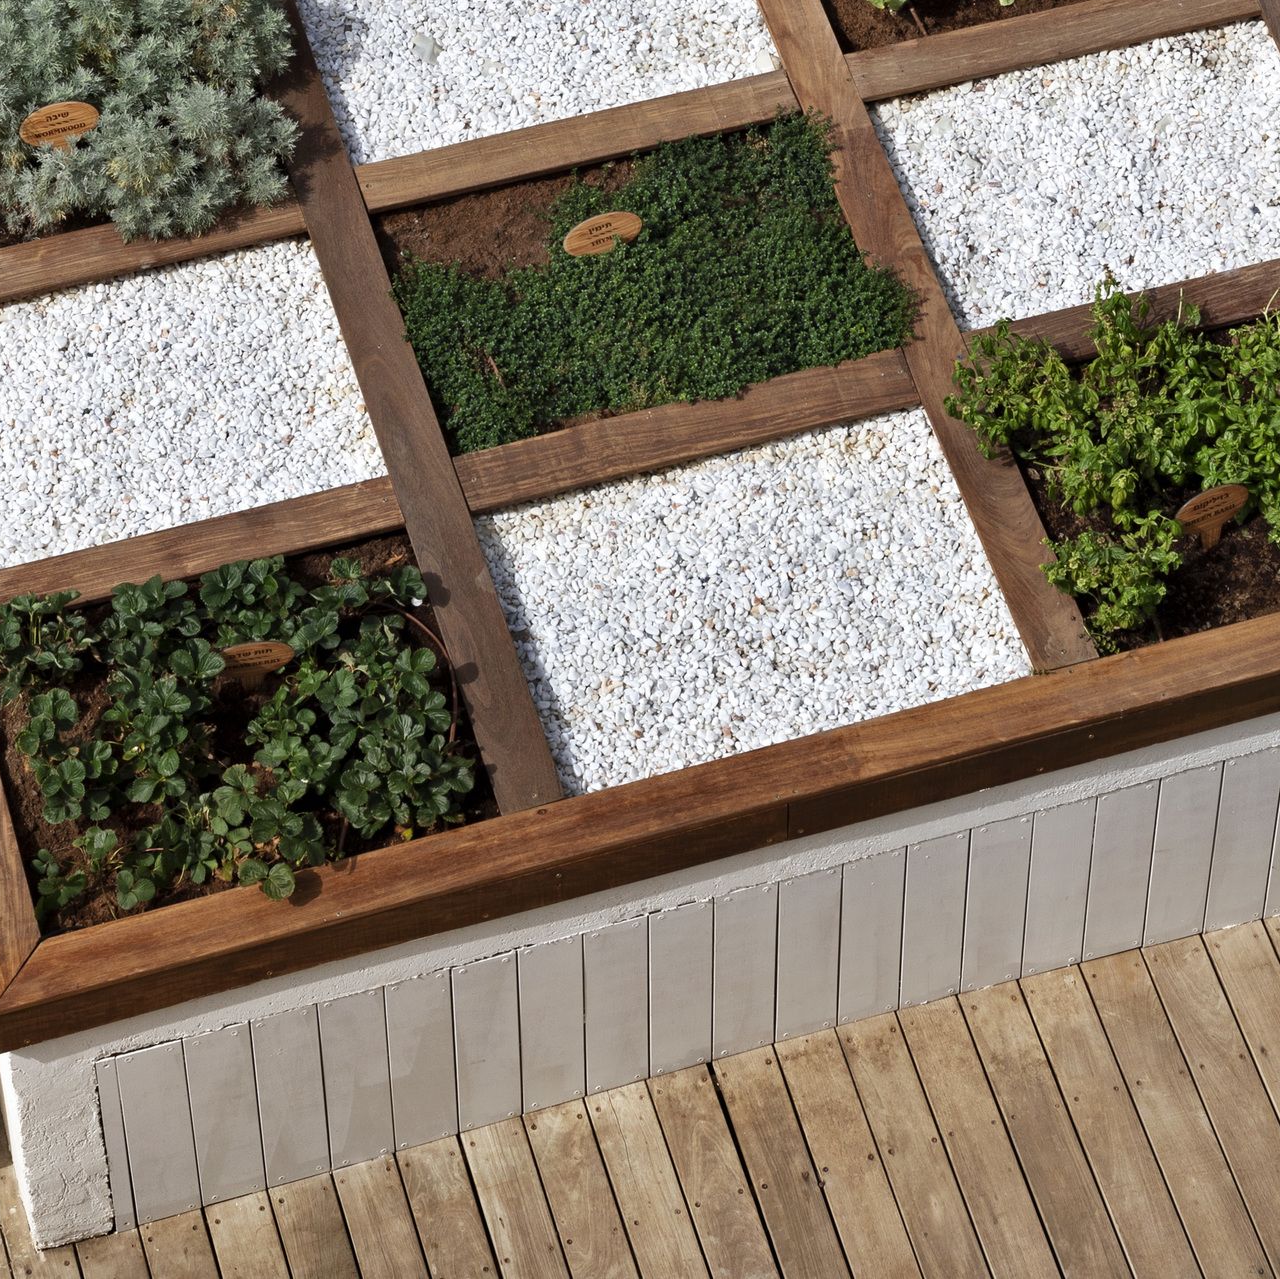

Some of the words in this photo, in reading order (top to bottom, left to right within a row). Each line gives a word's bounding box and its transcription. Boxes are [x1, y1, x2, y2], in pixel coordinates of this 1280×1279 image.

[46, 111, 69, 122] שיבה
[34, 122, 87, 138] WORMWOOD
[588, 222, 613, 235] תימין
[591, 234, 616, 247] THYM
[1214, 504, 1235, 516] BASIL
